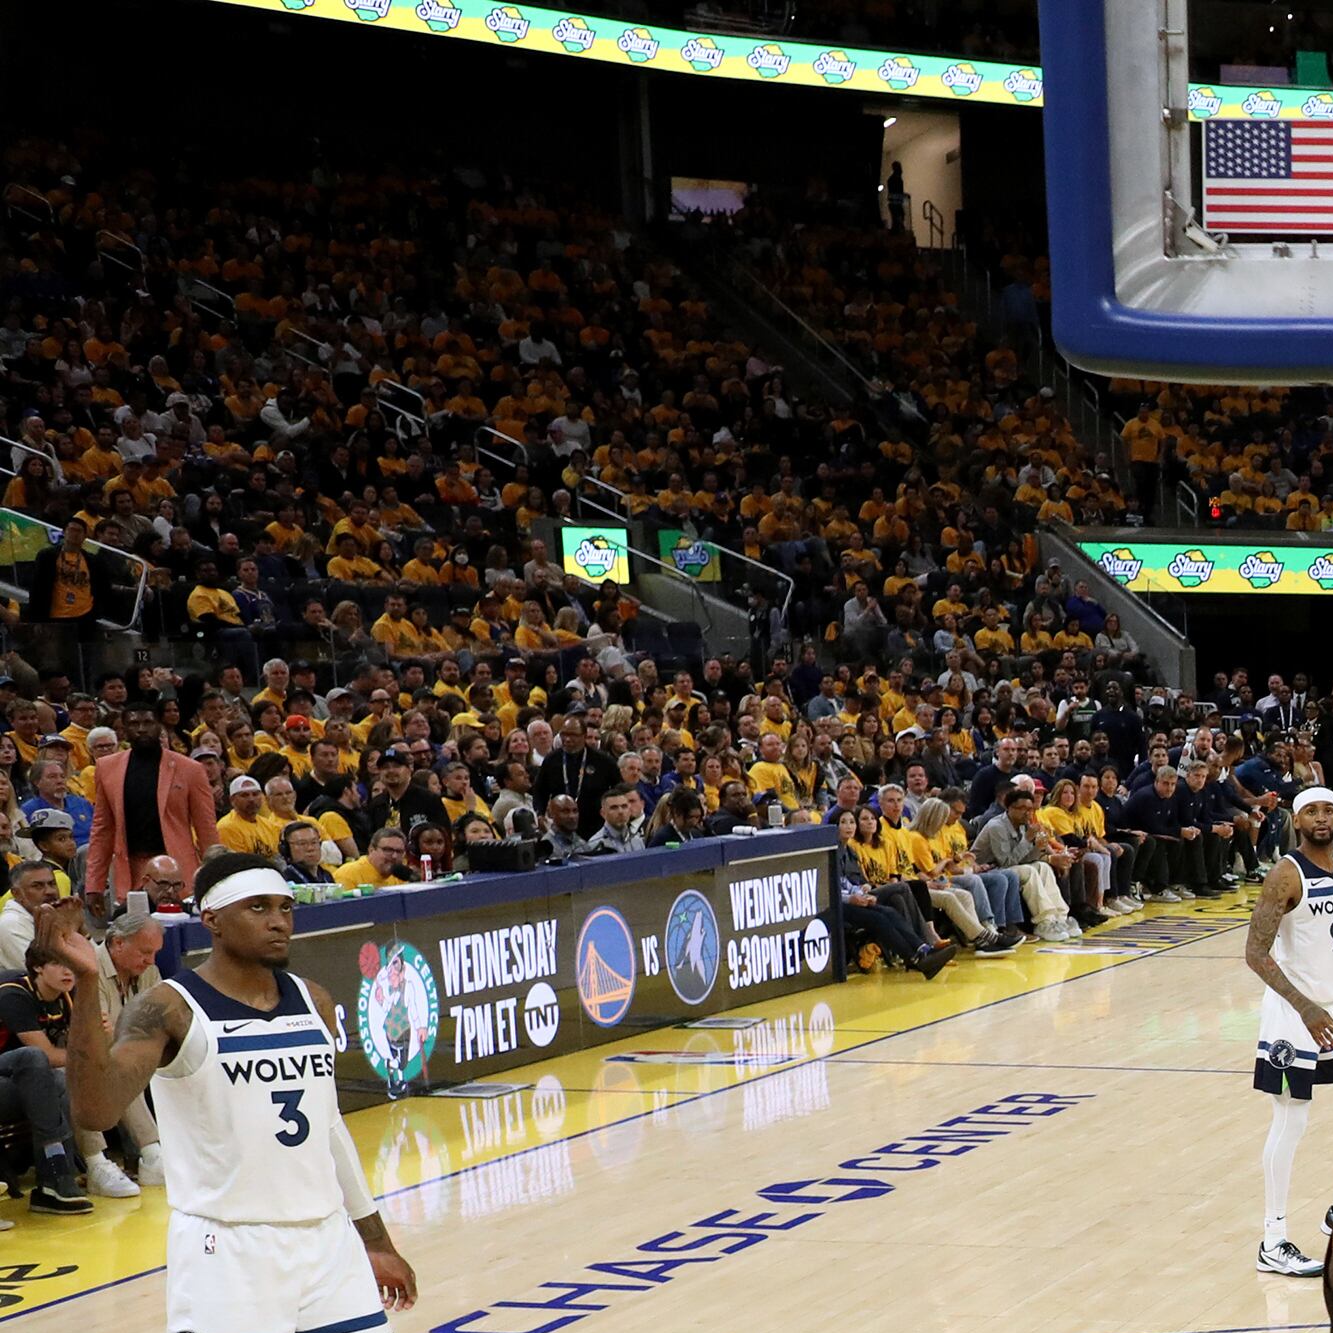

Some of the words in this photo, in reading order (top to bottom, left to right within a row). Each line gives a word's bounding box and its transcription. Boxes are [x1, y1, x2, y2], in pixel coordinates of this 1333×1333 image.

[416, 0, 462, 29] Starry
[485, 7, 530, 39] Starry
[552, 17, 596, 48] Starry
[617, 27, 659, 59] Starry
[681, 38, 725, 69] Starry
[746, 44, 792, 73] Starry
[813, 50, 856, 80] Starry
[877, 57, 921, 86] Starry
[941, 63, 983, 92] Starry
[1003, 69, 1042, 98] Starry
[1242, 91, 1282, 118] Starry
[575, 539, 618, 571] Starry
[1098, 550, 1143, 582] Starry
[1168, 552, 1215, 583] Starry
[1239, 554, 1285, 584] Starry
[729, 868, 818, 931] WEDNESDAY
[439, 919, 557, 997] WEDNESDAY
[641, 935, 659, 977] VS
[728, 932, 783, 990] 9:30PM
[783, 930, 801, 976] ET
[414, 954, 438, 1037] CELTICS
[335, 1004, 347, 1053] S
[358, 980, 381, 1067] BOSTON
[450, 1003, 495, 1063] 7PM
[496, 997, 517, 1053] ET
[221, 1053, 333, 1086] WOLVES
[271, 1089, 310, 1147] 3
[838, 1091, 1097, 1172] CENTER
